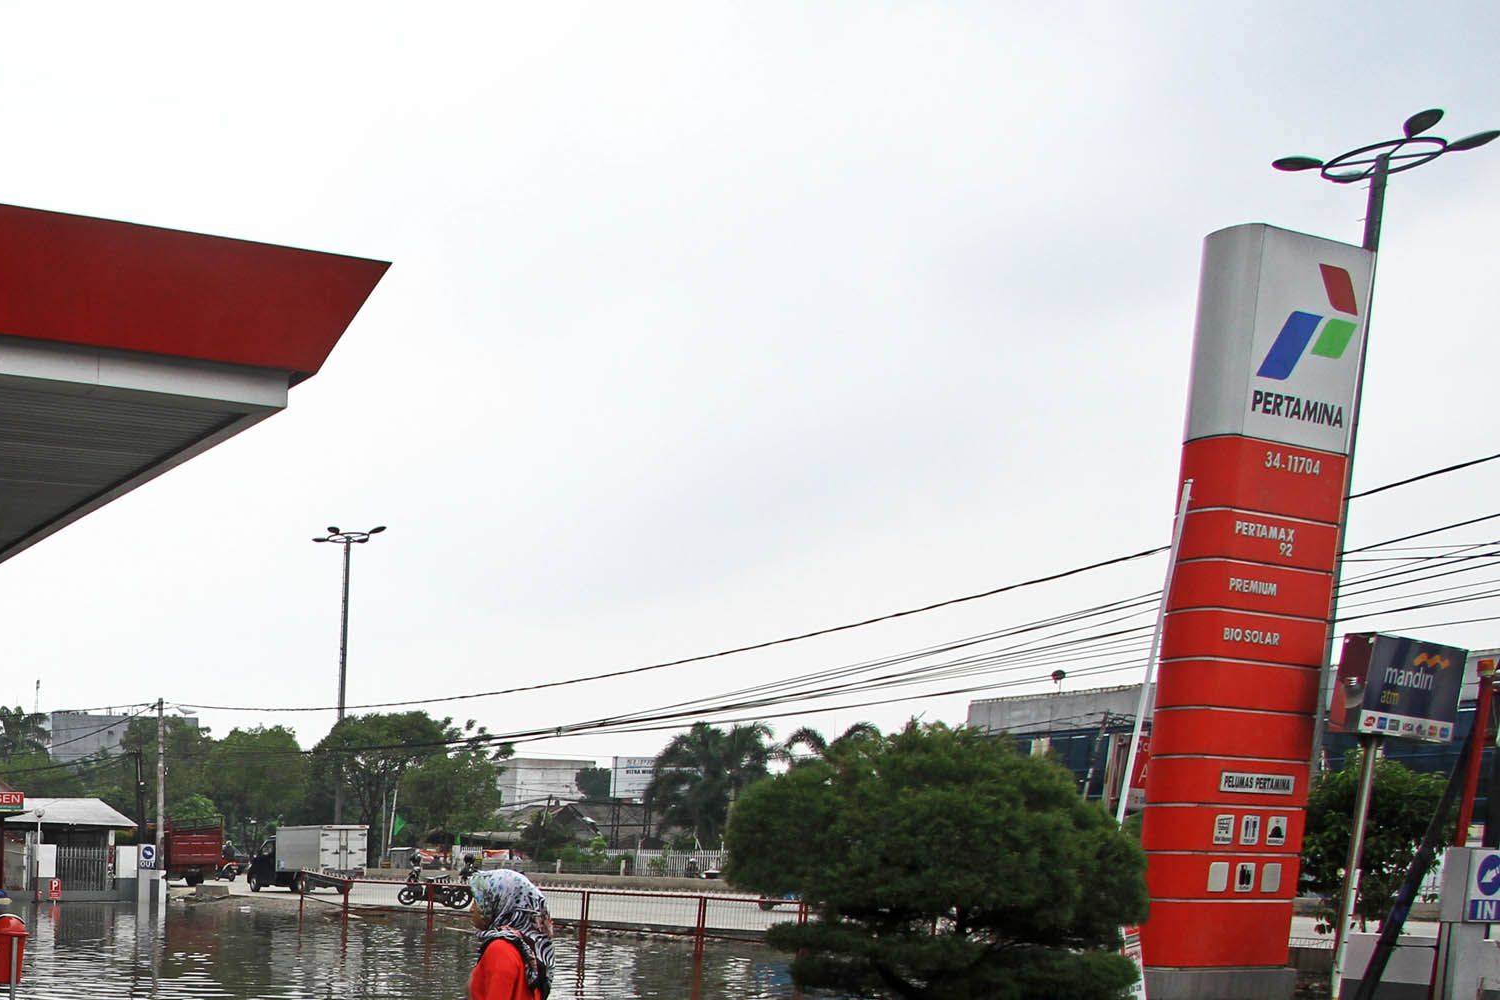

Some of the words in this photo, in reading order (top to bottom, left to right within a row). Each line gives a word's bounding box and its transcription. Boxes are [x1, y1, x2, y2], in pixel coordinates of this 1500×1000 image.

[1251, 390, 1343, 428] PERTAMINA
[1234, 520, 1295, 542] PERTAMAX
[1278, 543, 1293, 556] 92
[1228, 577, 1278, 597] PREMIUM
[1222, 627, 1242, 642] BIO
[1243, 630, 1280, 647] SOLAR
[1380, 690, 1400, 705] atm
[1223, 775, 1255, 790] PELUMAS
[1254, 777, 1291, 792] PERTAMINA
[52, 881, 59, 891] P
[1477, 901, 1496, 919] IN
